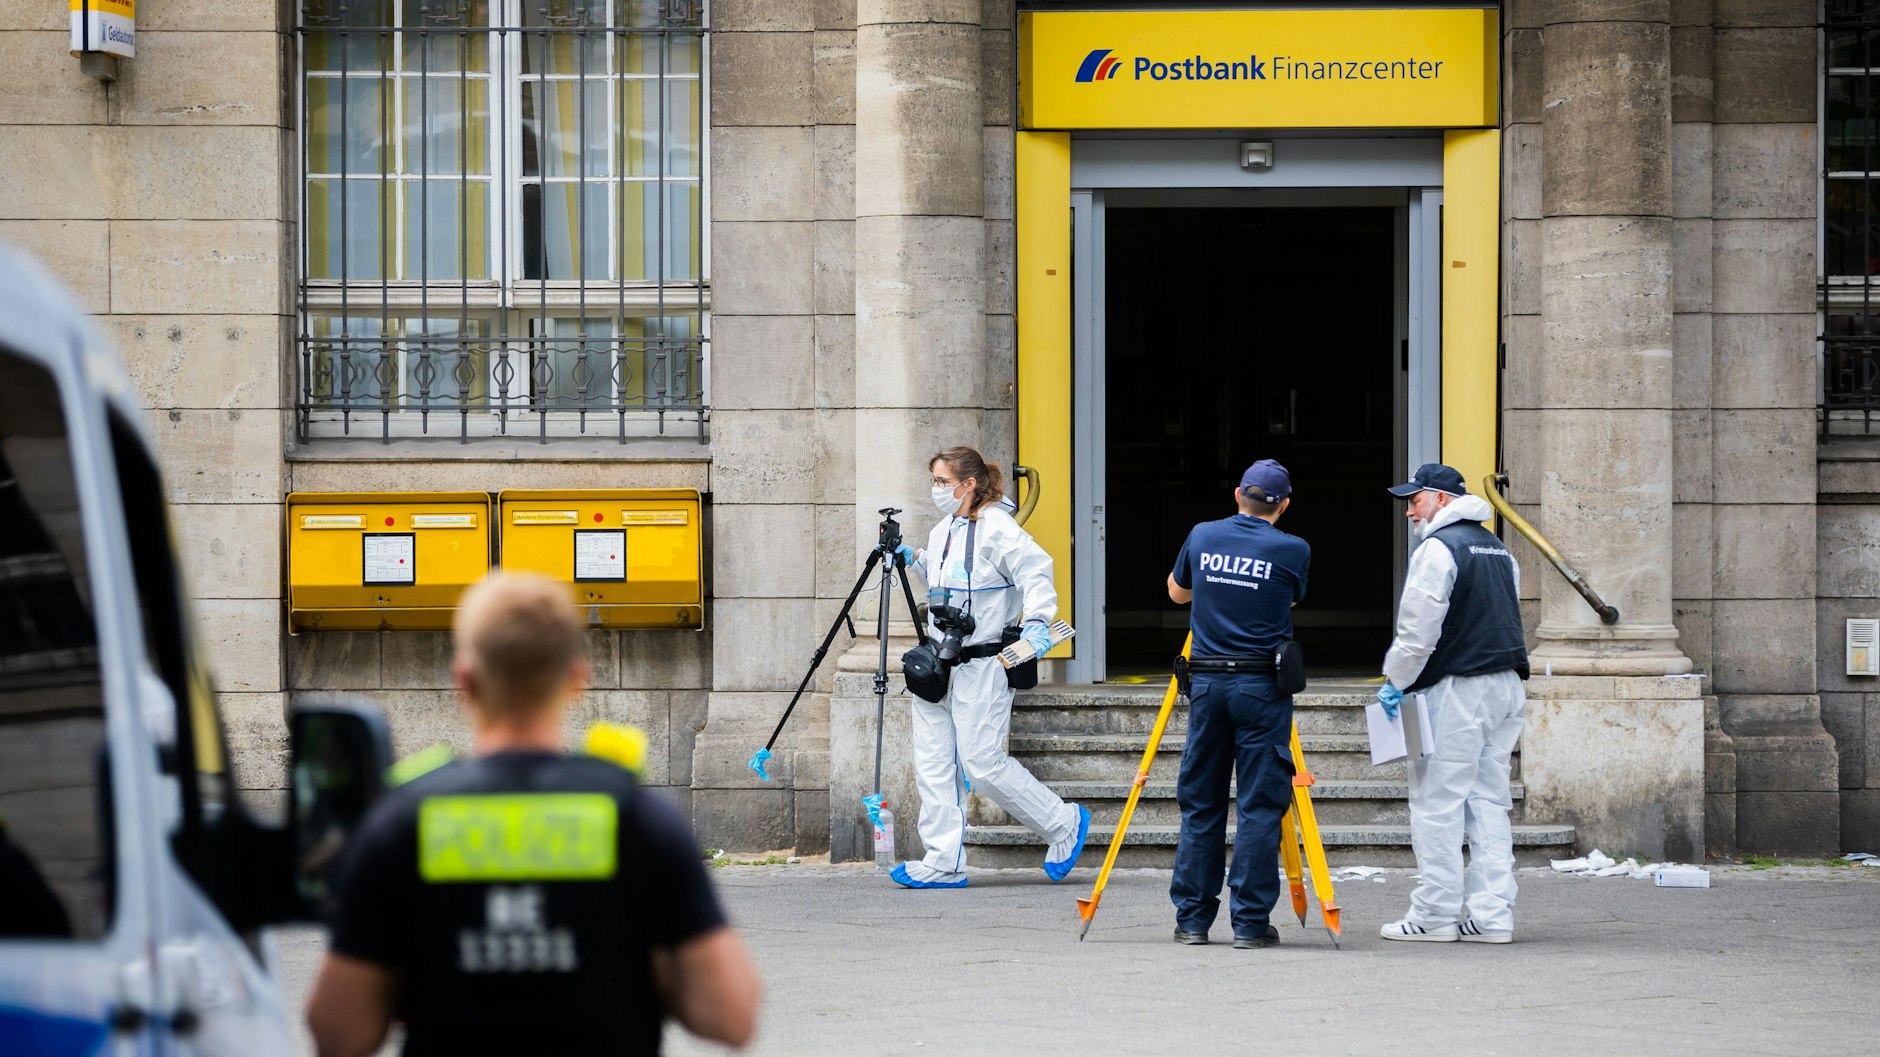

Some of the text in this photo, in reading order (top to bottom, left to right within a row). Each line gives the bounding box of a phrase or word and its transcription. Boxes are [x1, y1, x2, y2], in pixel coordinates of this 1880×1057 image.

[1134, 55, 1444, 81] Postbank Finanzcenter
[1200, 552, 1273, 580] POLIZEI
